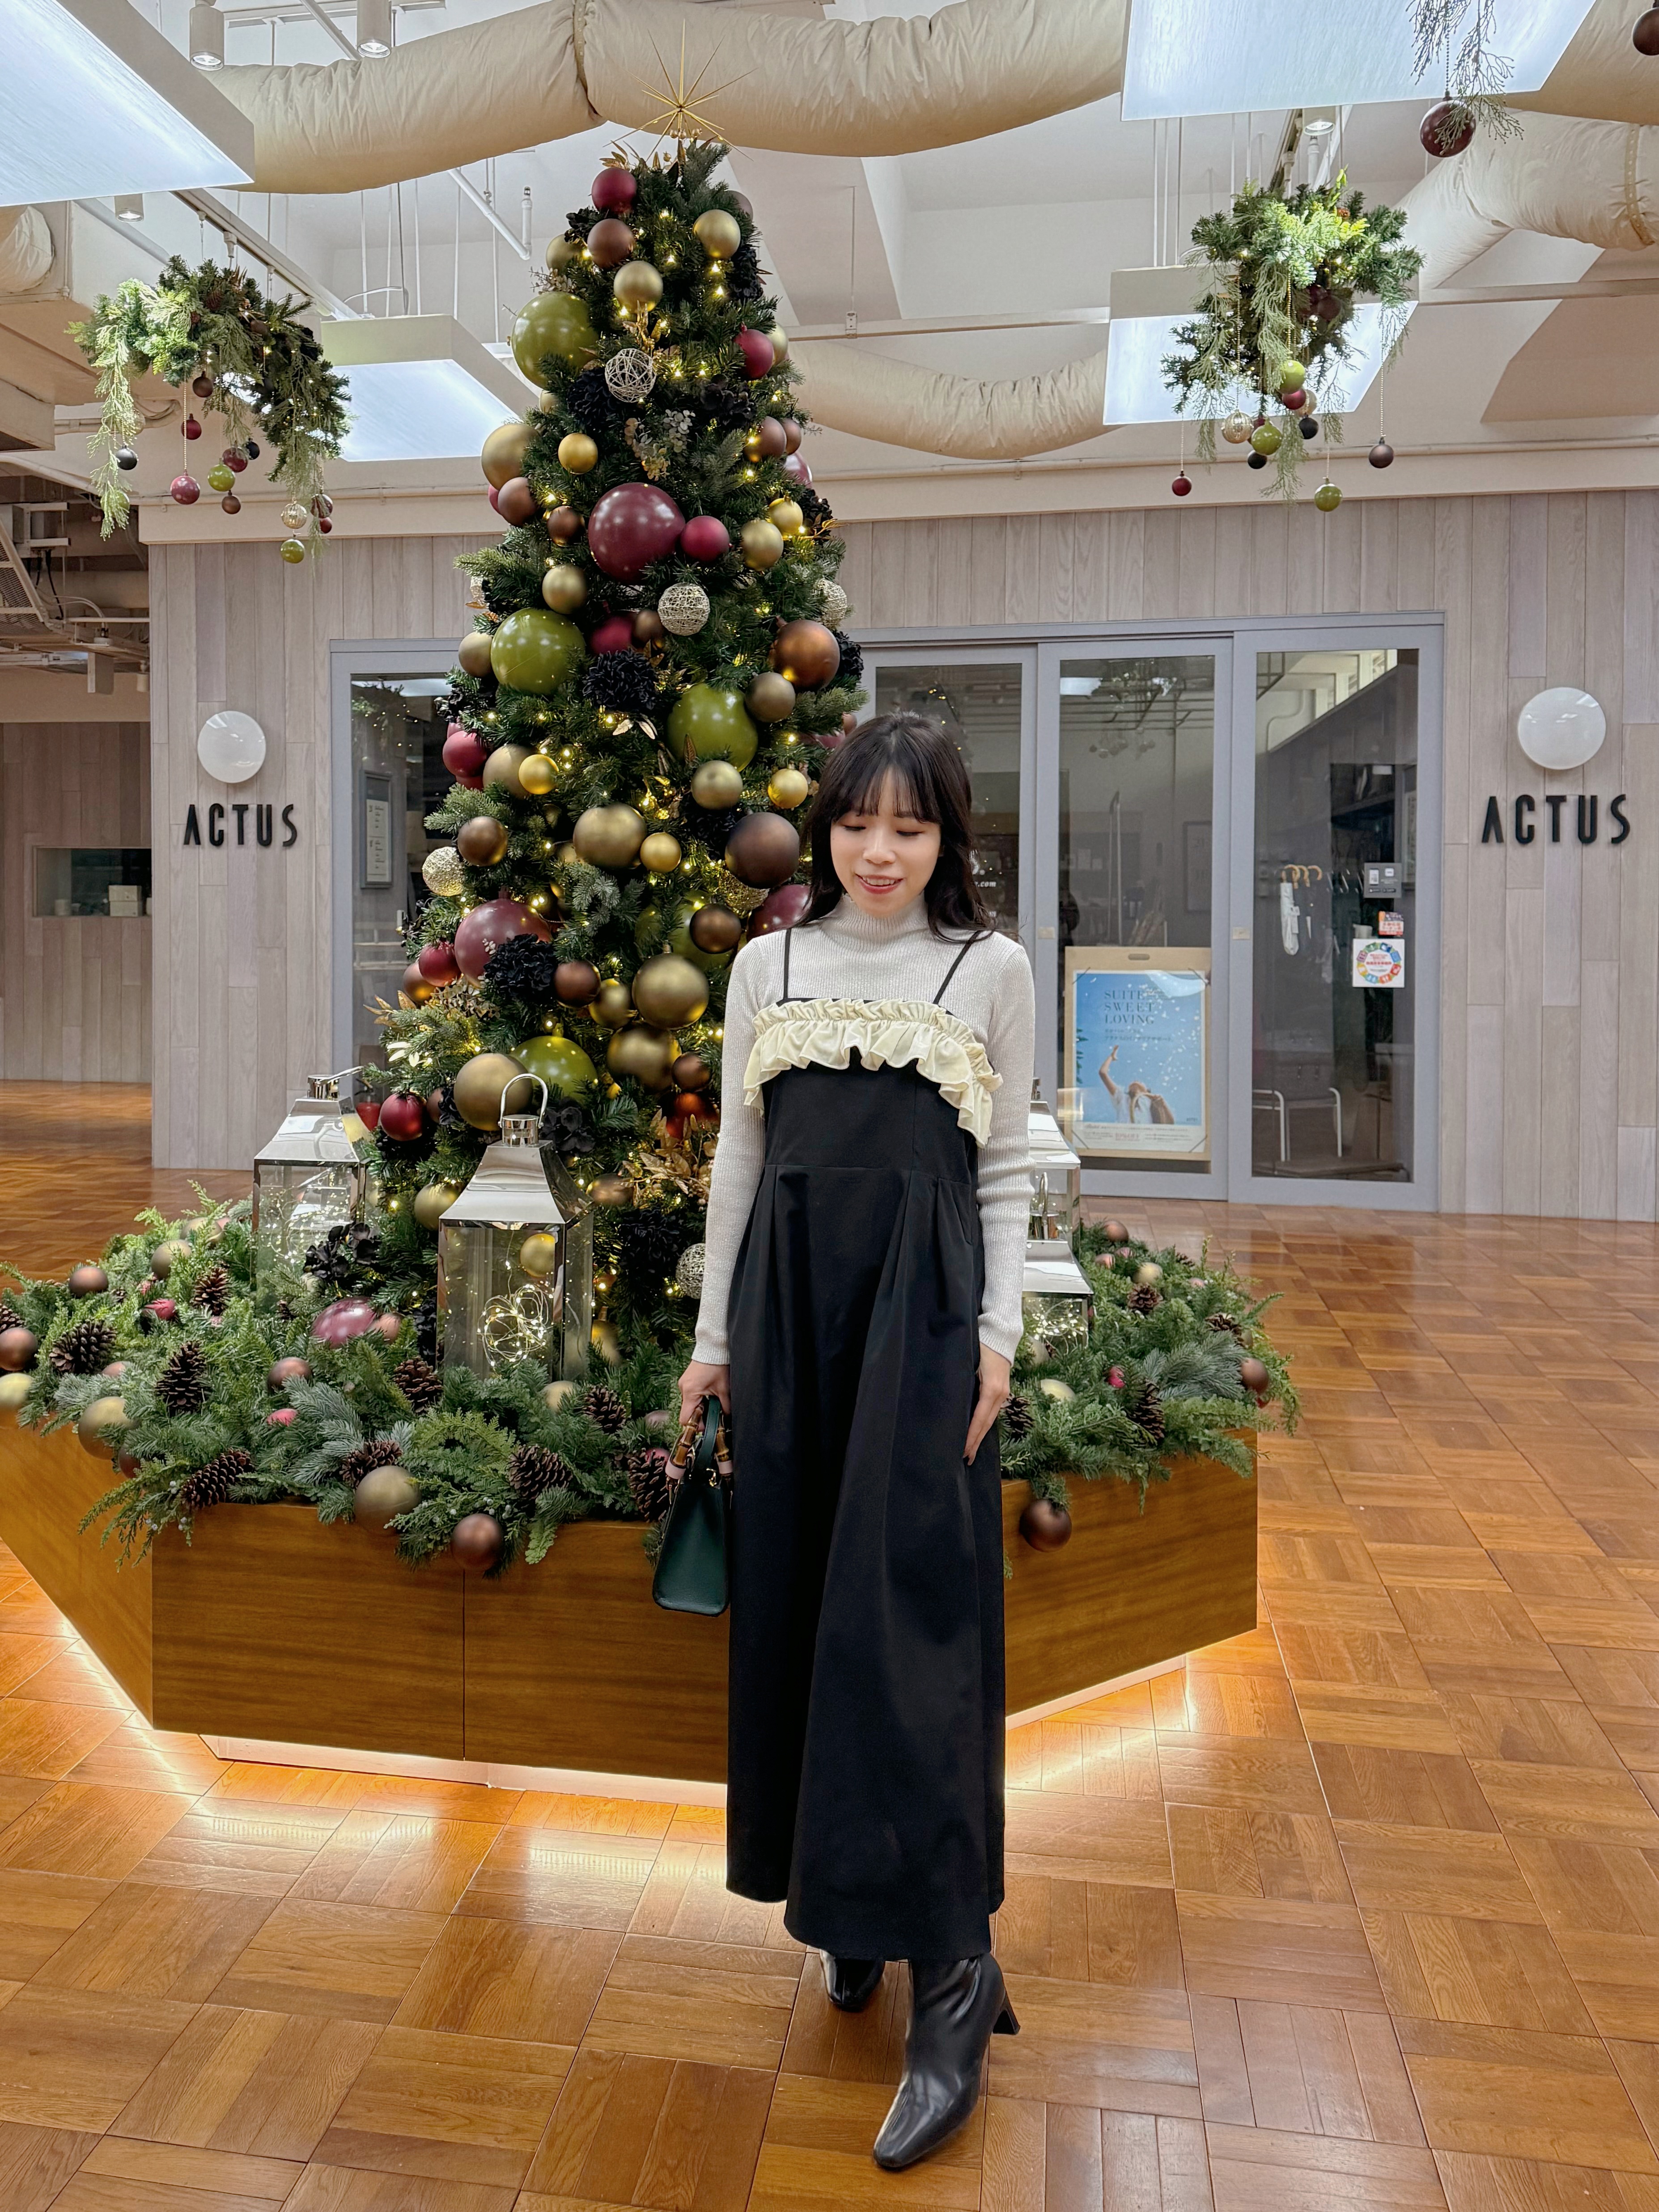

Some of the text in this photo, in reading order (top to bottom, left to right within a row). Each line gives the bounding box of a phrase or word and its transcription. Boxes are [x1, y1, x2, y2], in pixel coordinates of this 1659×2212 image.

[1481, 794, 1630, 844] ACTUS
[183, 803, 297, 847] ACTUS
[1104, 990, 1146, 1000] SUITE
[1104, 1002, 1155, 1012] SWEET
[1105, 1014, 1154, 1024] LOVING
